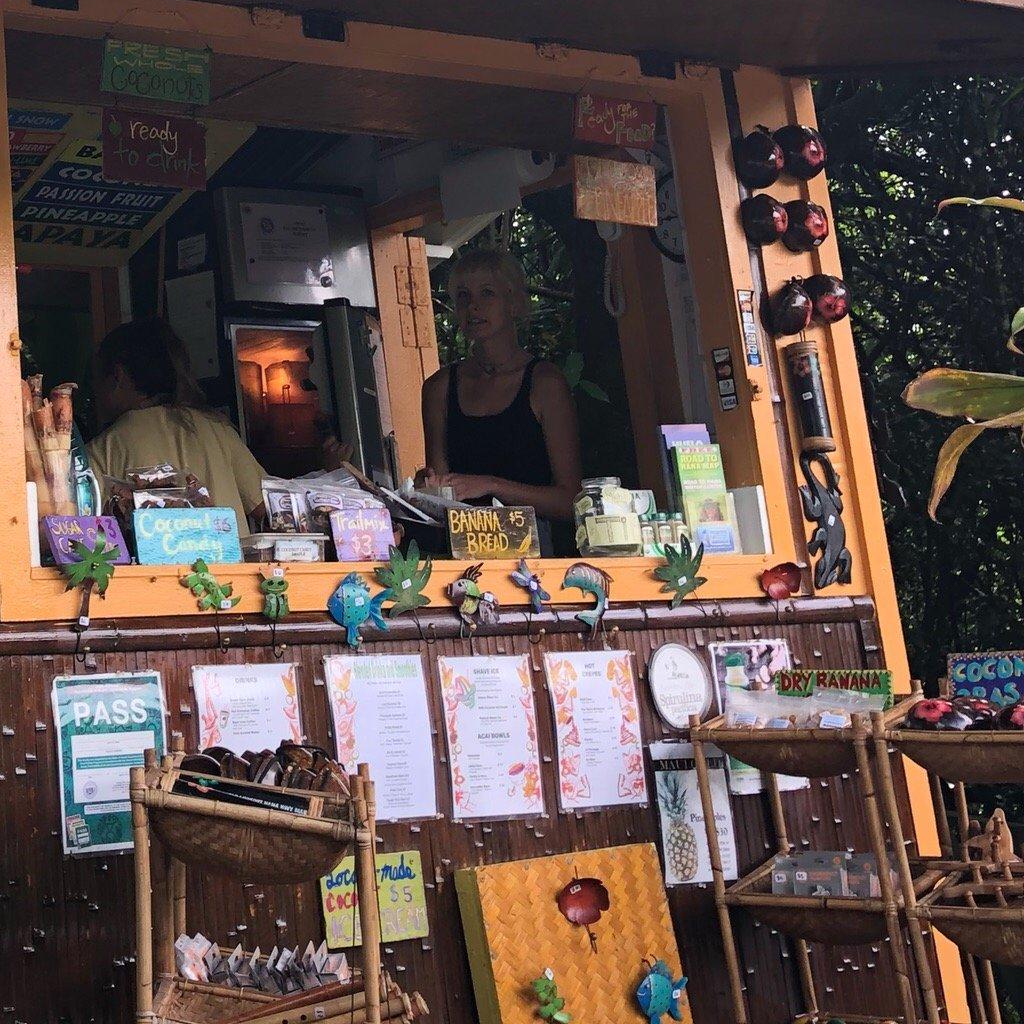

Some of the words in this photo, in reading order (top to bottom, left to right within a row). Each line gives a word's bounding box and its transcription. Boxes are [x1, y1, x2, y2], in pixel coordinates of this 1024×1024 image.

[129, 120, 178, 155] ready
[35, 185, 107, 205] PASSION
[111, 191, 164, 209] FRUIT
[20, 206, 142, 226] PINEAPPLE
[138, 512, 211, 538] Coconut
[450, 509, 503, 534] BANANA
[509, 511, 524, 527] $5
[162, 536, 223, 562] Candy
[351, 534, 373, 556] $3
[466, 532, 509, 553] BREAD
[780, 672, 812, 692] DRY
[73, 697, 148, 727] PASS
